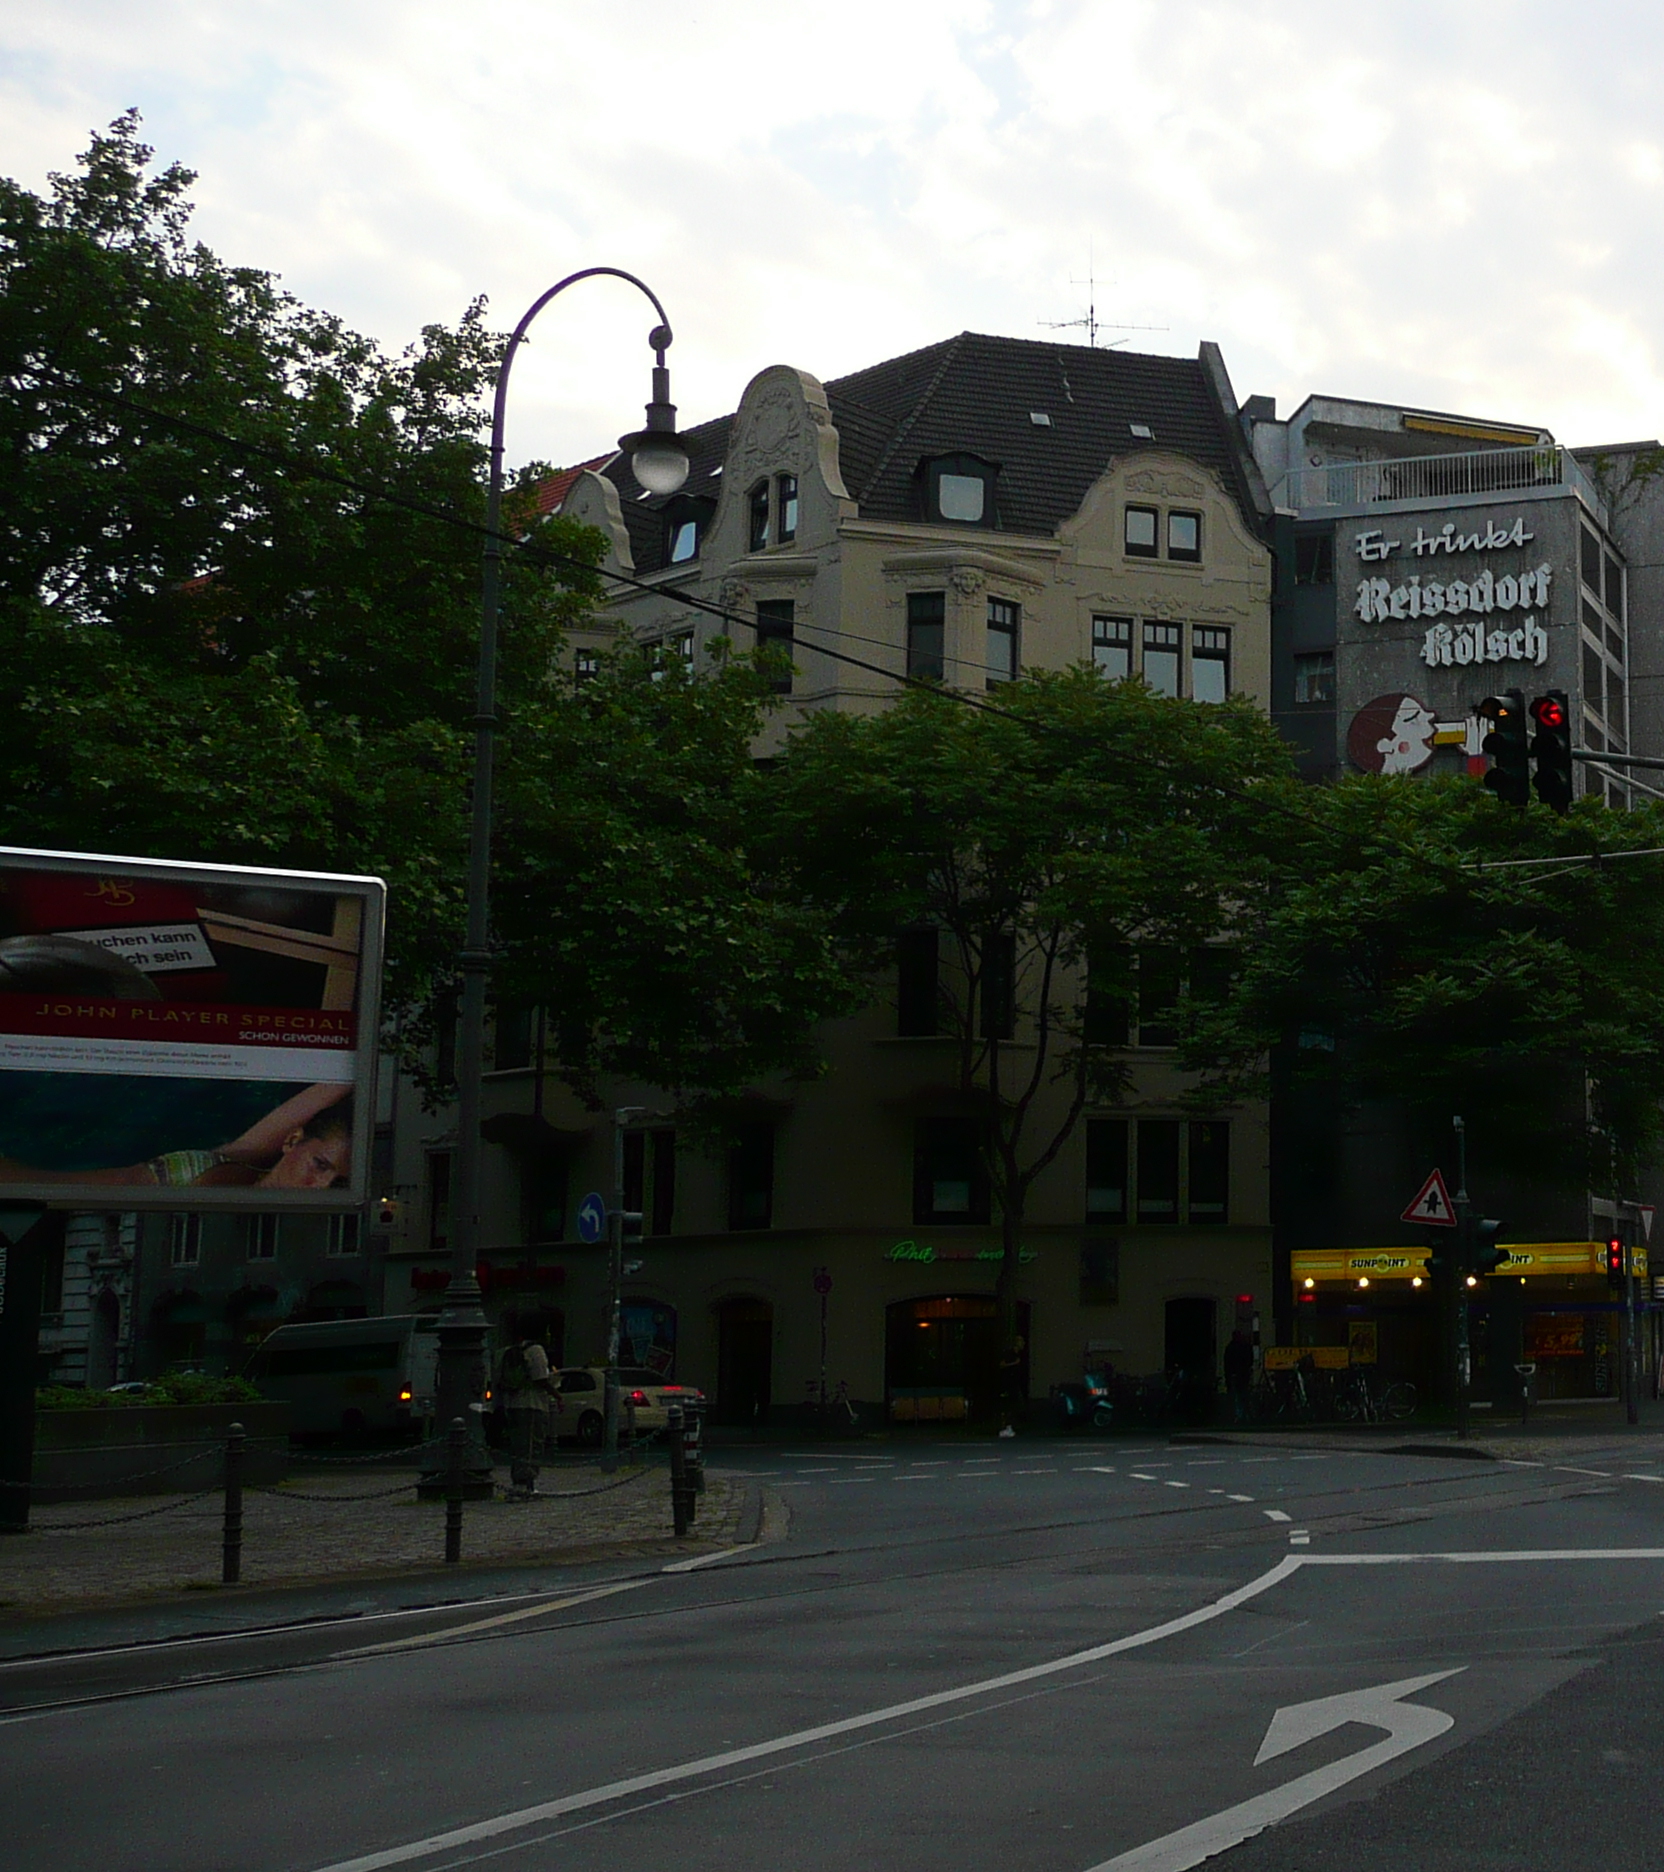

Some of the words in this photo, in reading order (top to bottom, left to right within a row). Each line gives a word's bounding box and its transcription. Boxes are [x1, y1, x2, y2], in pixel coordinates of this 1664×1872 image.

[1354, 529, 1400, 562] Er
[1410, 517, 1534, 557] trinkt
[1353, 562, 1553, 624] Reissdorf
[1419, 614, 1549, 668] Kölsch
[151, 932, 197, 945] kann
[155, 948, 193, 963] sein
[35, 1002, 117, 1020] JOHN
[130, 1008, 230, 1026] PLAYER
[238, 1013, 350, 1031] SPECIAL
[238, 1030, 279, 1043] SCHON
[281, 1032, 350, 1046] GEWONNEN
